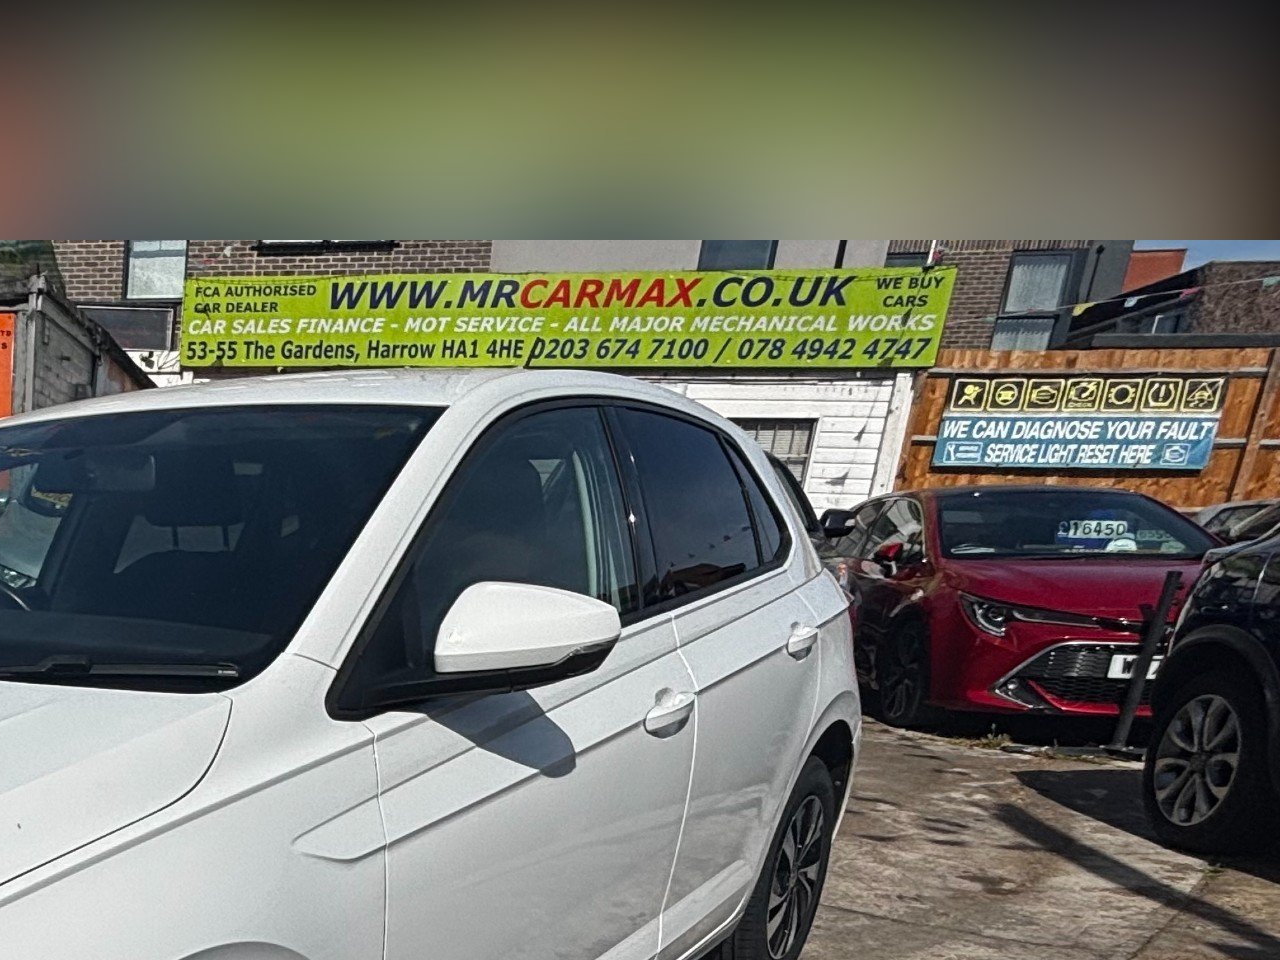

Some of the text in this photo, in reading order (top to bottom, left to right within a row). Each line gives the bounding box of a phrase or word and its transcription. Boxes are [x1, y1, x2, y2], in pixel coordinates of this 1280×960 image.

[195, 285, 317, 298] FCA AUTHORISED
[330, 276, 856, 310] WWW.MRCARMAX.CO.UK
[876, 276, 945, 290] WE BUY
[194, 302, 278, 314] CAR DEALER
[882, 295, 928, 308] CARS
[188, 319, 227, 335] CAR
[231, 318, 292, 334] SALES
[296, 317, 386, 334] FINANCE
[403, 317, 452, 333] MOT
[454, 316, 546, 333] SERVICE
[563, 316, 602, 333] ALL
[609, 316, 686, 333] MAJOR
[689, 315, 837, 332] MECHANICAL
[847, 314, 937, 332] WORKS
[186, 341, 237, 360] 53-55
[244, 340, 275, 360] The
[281, 340, 360, 363] Gardens,
[367, 340, 436, 359] Harrow
[441, 339, 478, 359] HA1
[486, 339, 524, 359] 4HE
[596, 338, 642, 360] 674
[647, 338, 709, 360] 7100
[737, 338, 786, 360] 078
[791, 338, 856, 360] 4942
[862, 337, 932, 360] 4747
[943, 420, 1215, 440] WE CAN DIAGNOSE YOUR FAULT
[984, 443, 1156, 464] SERVICE LIGHT RESET HERE
